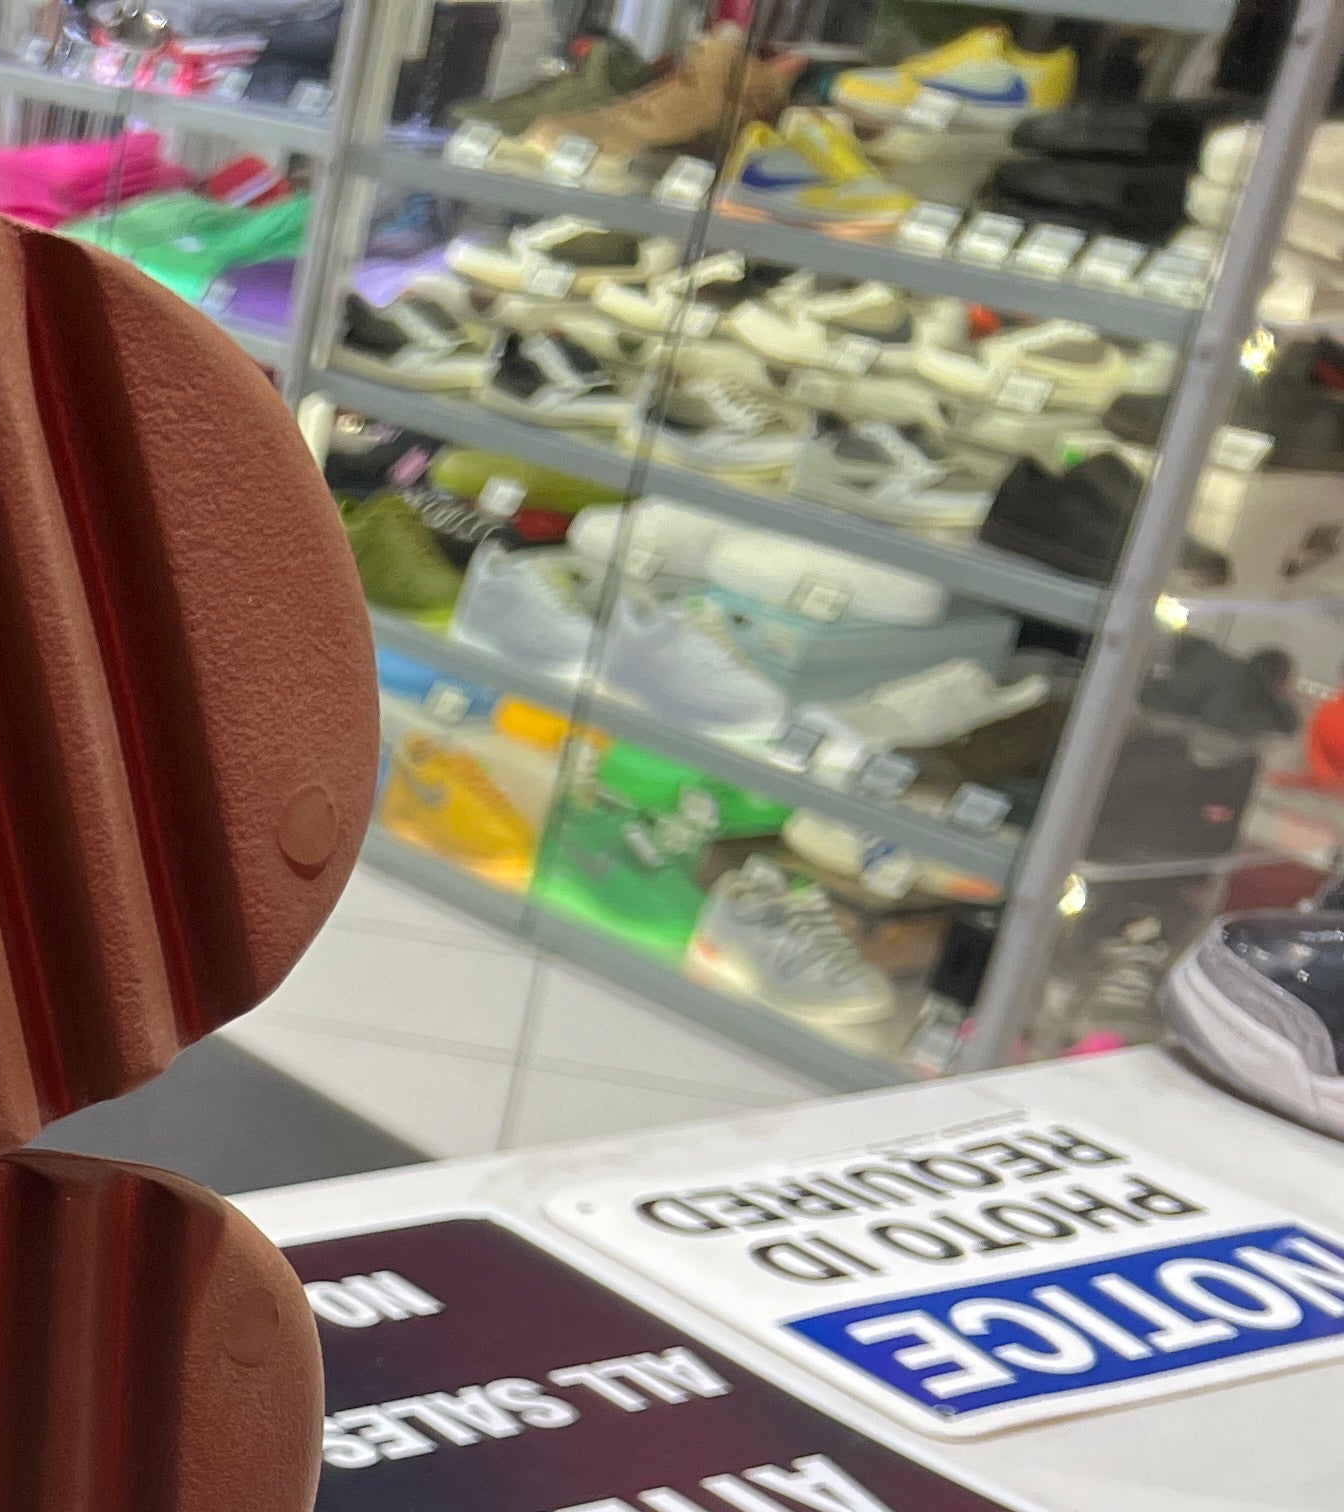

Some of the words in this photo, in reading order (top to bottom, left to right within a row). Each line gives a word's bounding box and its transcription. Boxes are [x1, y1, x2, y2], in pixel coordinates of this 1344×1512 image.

[633, 1124, 1130, 1237] REQUIRED
[868, 1173, 1210, 1266] PHOTO
[303, 1270, 446, 1328] NO
[747, 1229, 890, 1285] ID
[844, 1236, 1344, 1400] NOTICE
[322, 1378, 582, 1470] SALES
[547, 1346, 734, 1412] ALL
